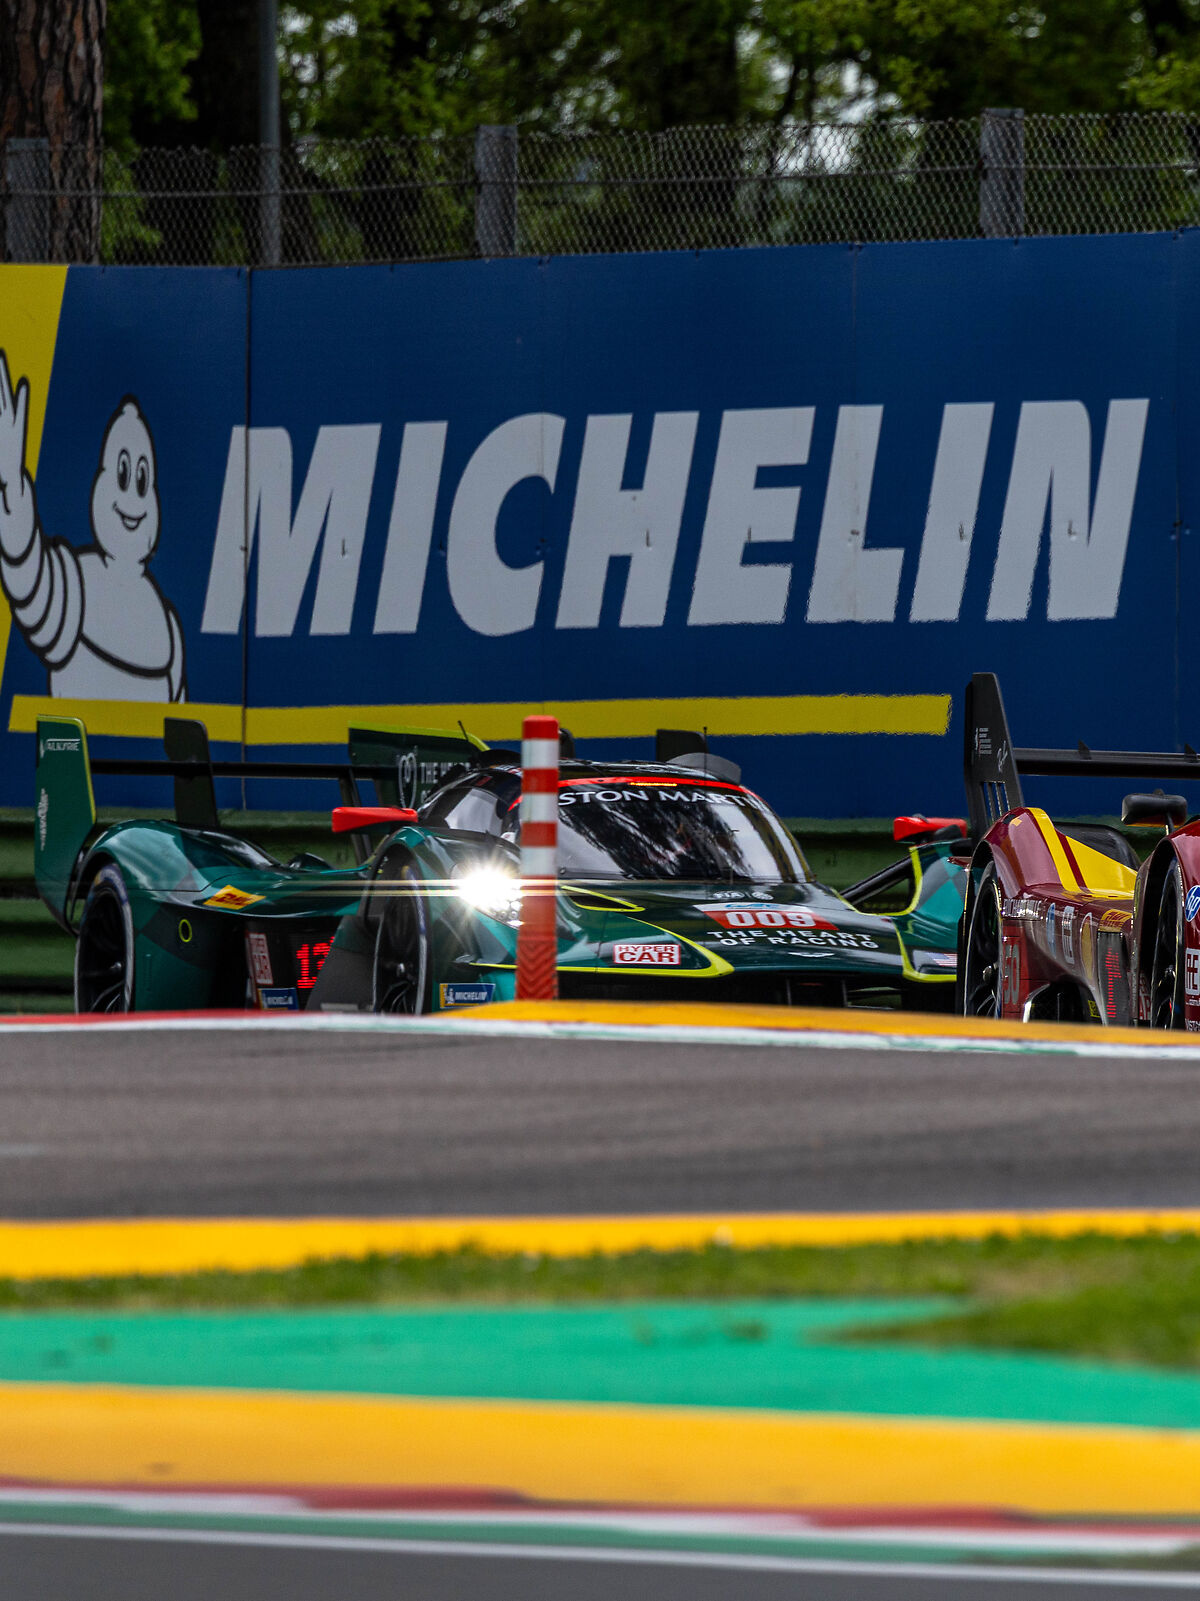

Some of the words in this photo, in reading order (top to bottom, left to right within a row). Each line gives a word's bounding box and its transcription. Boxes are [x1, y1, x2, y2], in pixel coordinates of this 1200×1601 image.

[201, 398, 1149, 637] MICHELIN
[558, 790, 649, 806] STON
[725, 911, 817, 927] 009
[707, 930, 768, 938] THE
[776, 930, 871, 941] HEART
[720, 938, 756, 946] OF
[769, 937, 879, 949] RACING
[618, 951, 675, 963] CAR
